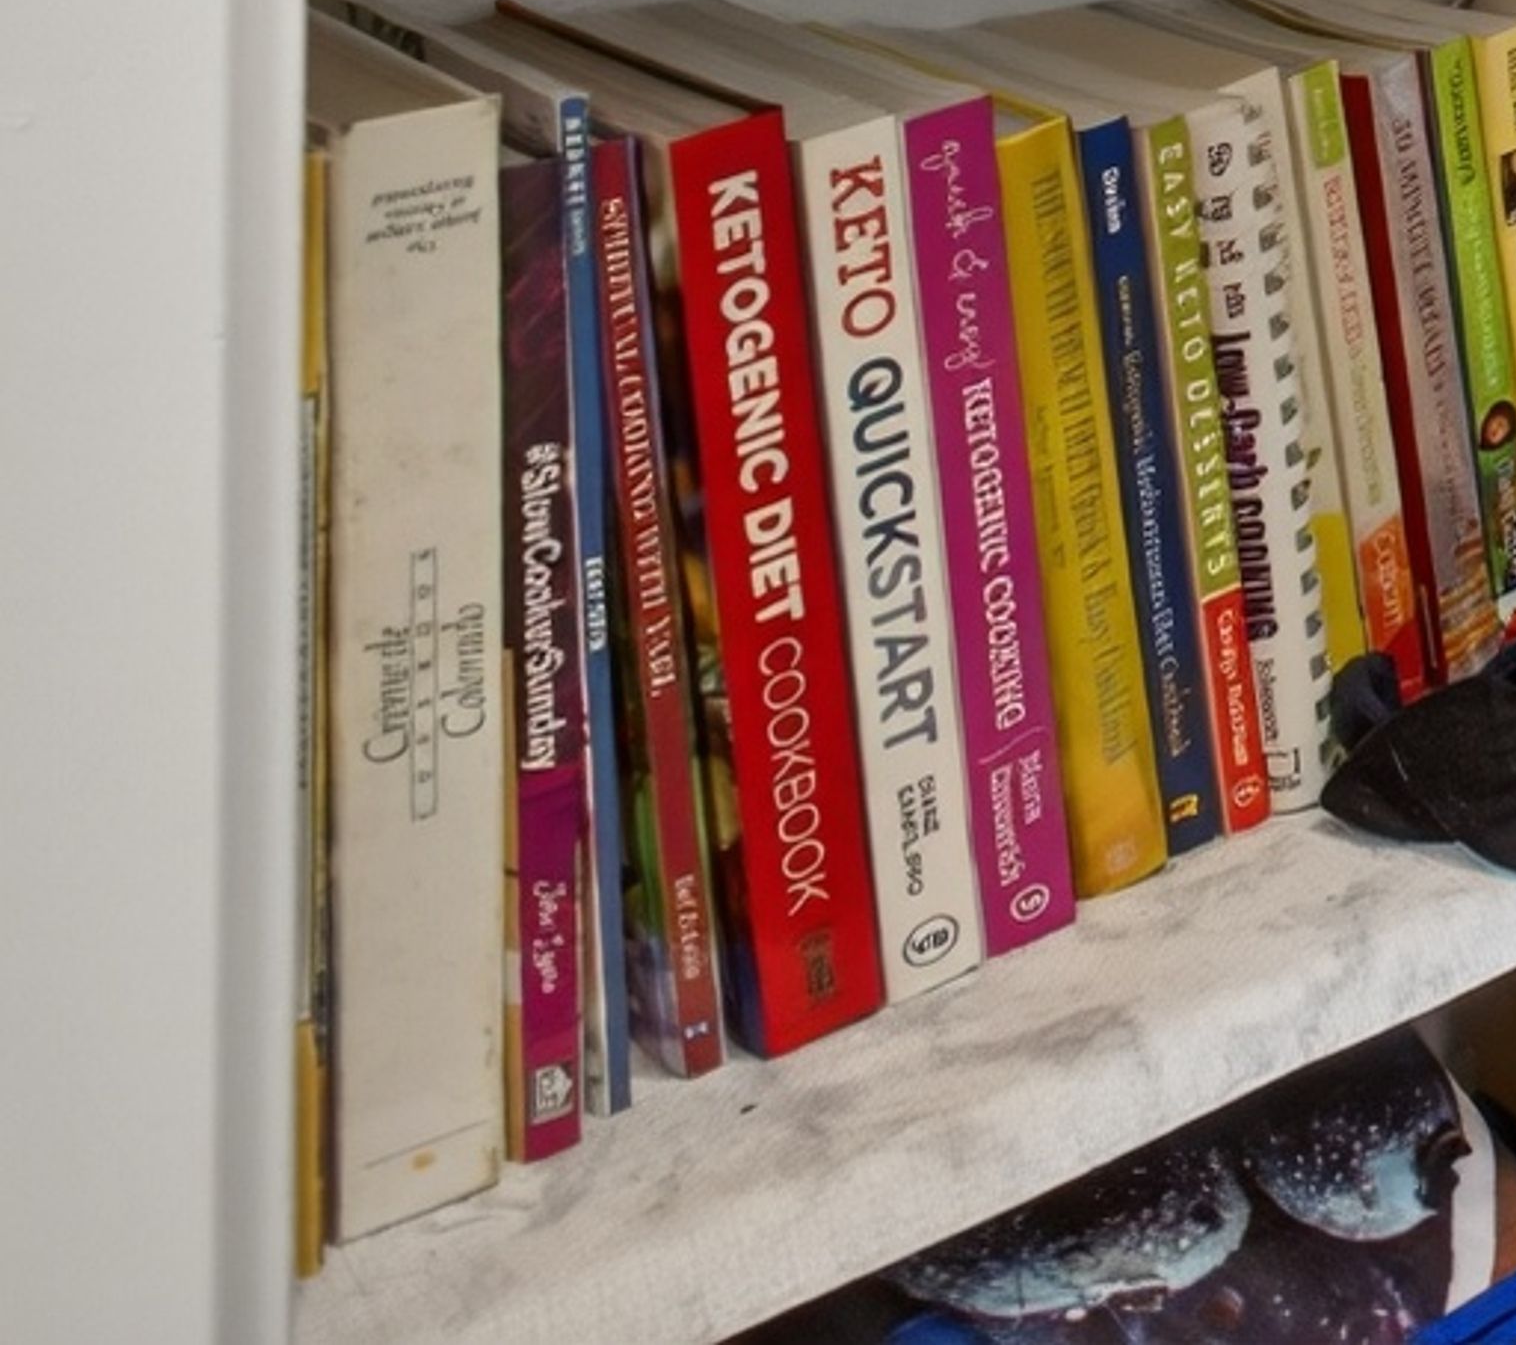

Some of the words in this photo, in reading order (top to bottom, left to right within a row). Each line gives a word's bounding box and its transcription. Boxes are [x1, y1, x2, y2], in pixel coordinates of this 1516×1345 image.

[830, 154, 898, 339] KETO
[1158, 140, 1193, 241] EASY
[708, 167, 789, 496] KETOGENIC
[1174, 258, 1206, 364] KETO
[744, 496, 803, 624] DIET
[846, 357, 937, 751] QUICKSTART
[962, 376, 1012, 575] KETOGENIC
[980, 575, 1027, 734] COOKING
[757, 636, 830, 917] COOKBOOK
